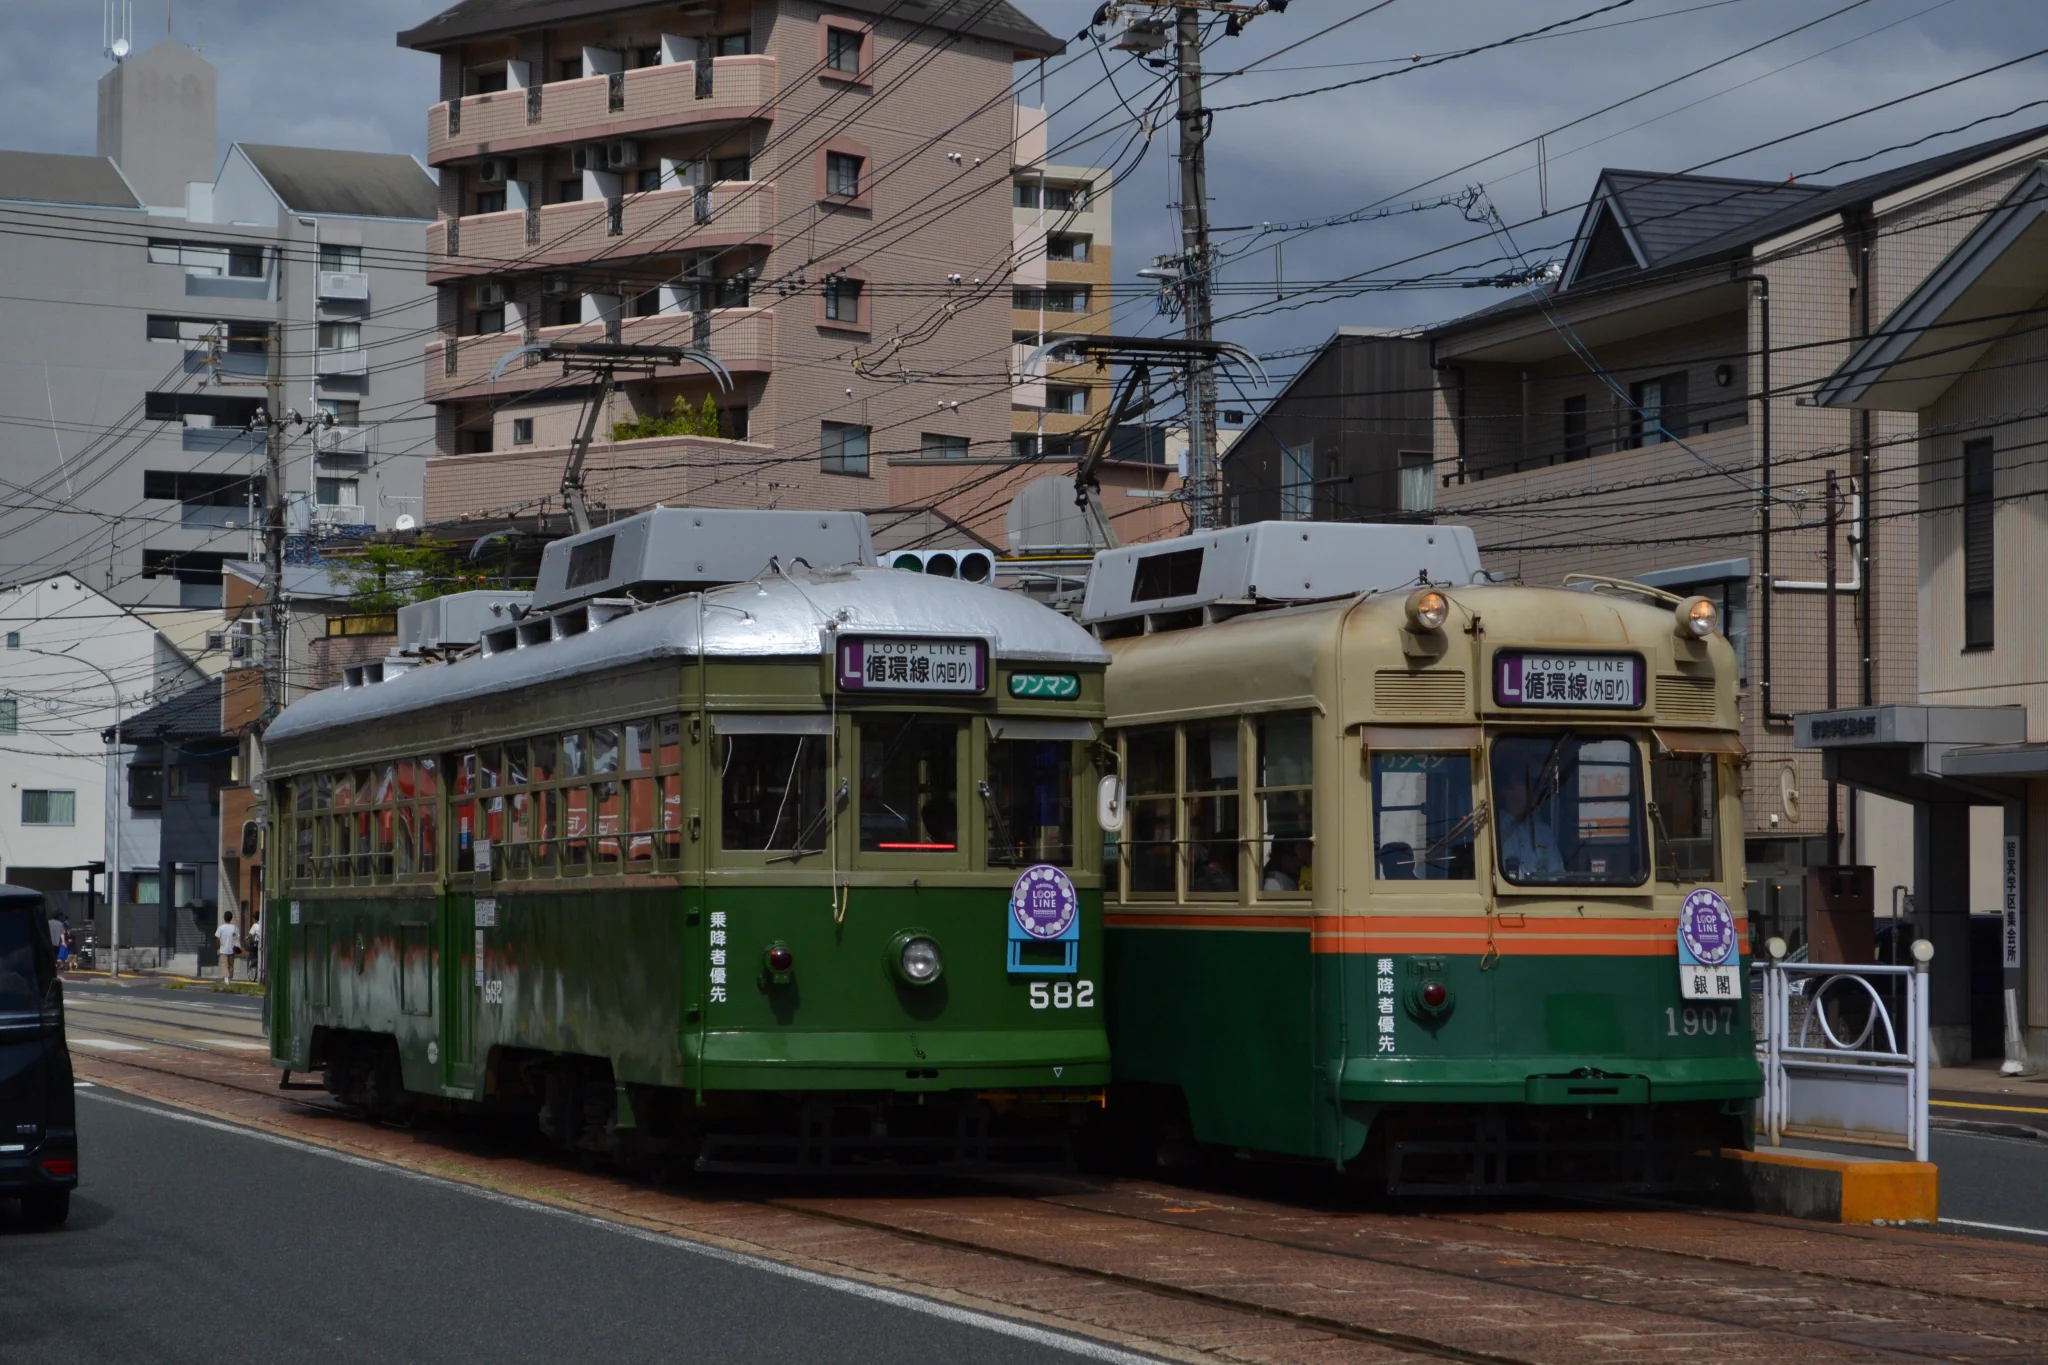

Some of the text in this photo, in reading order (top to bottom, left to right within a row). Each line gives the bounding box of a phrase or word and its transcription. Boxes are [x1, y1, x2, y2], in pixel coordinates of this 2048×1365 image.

[844, 646, 861, 678] L
[872, 643, 967, 656] LOOP LINE
[866, 655, 973, 684] 循環線(内回り)
[1531, 659, 1625, 672] LOOP LINE
[1011, 674, 1077, 695] ワンマン
[1503, 663, 1520, 696] L
[1524, 671, 1630, 702] 循環線(外回り)
[1032, 889, 1057, 899] LOOP
[1033, 899, 1056, 908] LINE
[2006, 840, 2017, 963] 皆実学区集会所
[1696, 914, 1717, 924] LOOP
[1697, 923, 1719, 933] LINE
[709, 911, 727, 1004] 乗降者優先
[485, 979, 503, 1005] 582
[1029, 979, 1095, 1009] 582
[1693, 974, 1731, 996] 銀閣
[1377, 958, 1396, 1053] 乗降者優先
[1665, 1006, 1734, 1037] 1907
